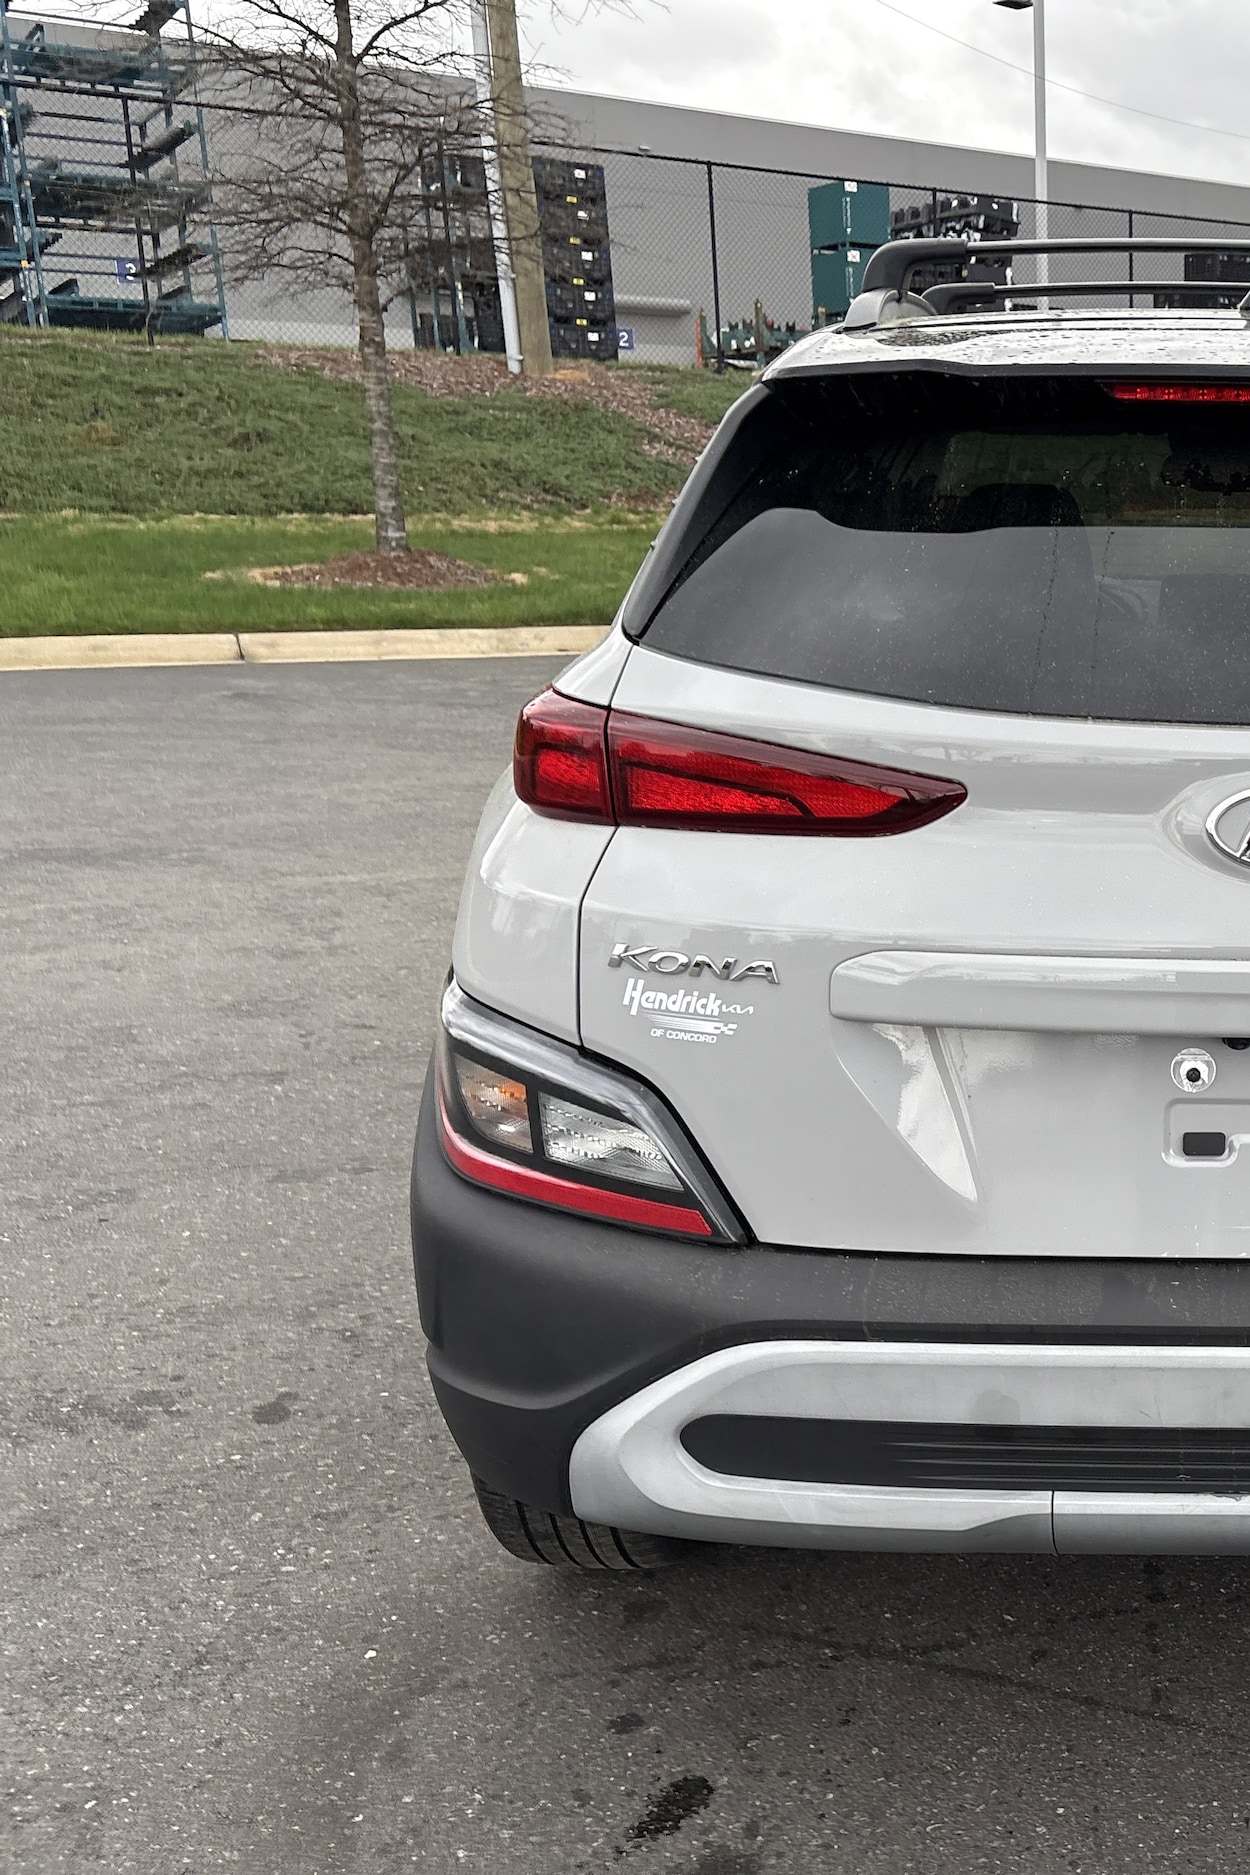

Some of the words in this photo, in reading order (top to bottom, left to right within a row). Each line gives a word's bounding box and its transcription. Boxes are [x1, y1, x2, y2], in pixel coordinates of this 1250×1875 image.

[618, 331, 630, 347] 2
[608, 943, 780, 985] KONA
[622, 978, 722, 1016] Hendrick
[650, 1027, 664, 1038] OF
[666, 1029, 717, 1044] CONCORD
